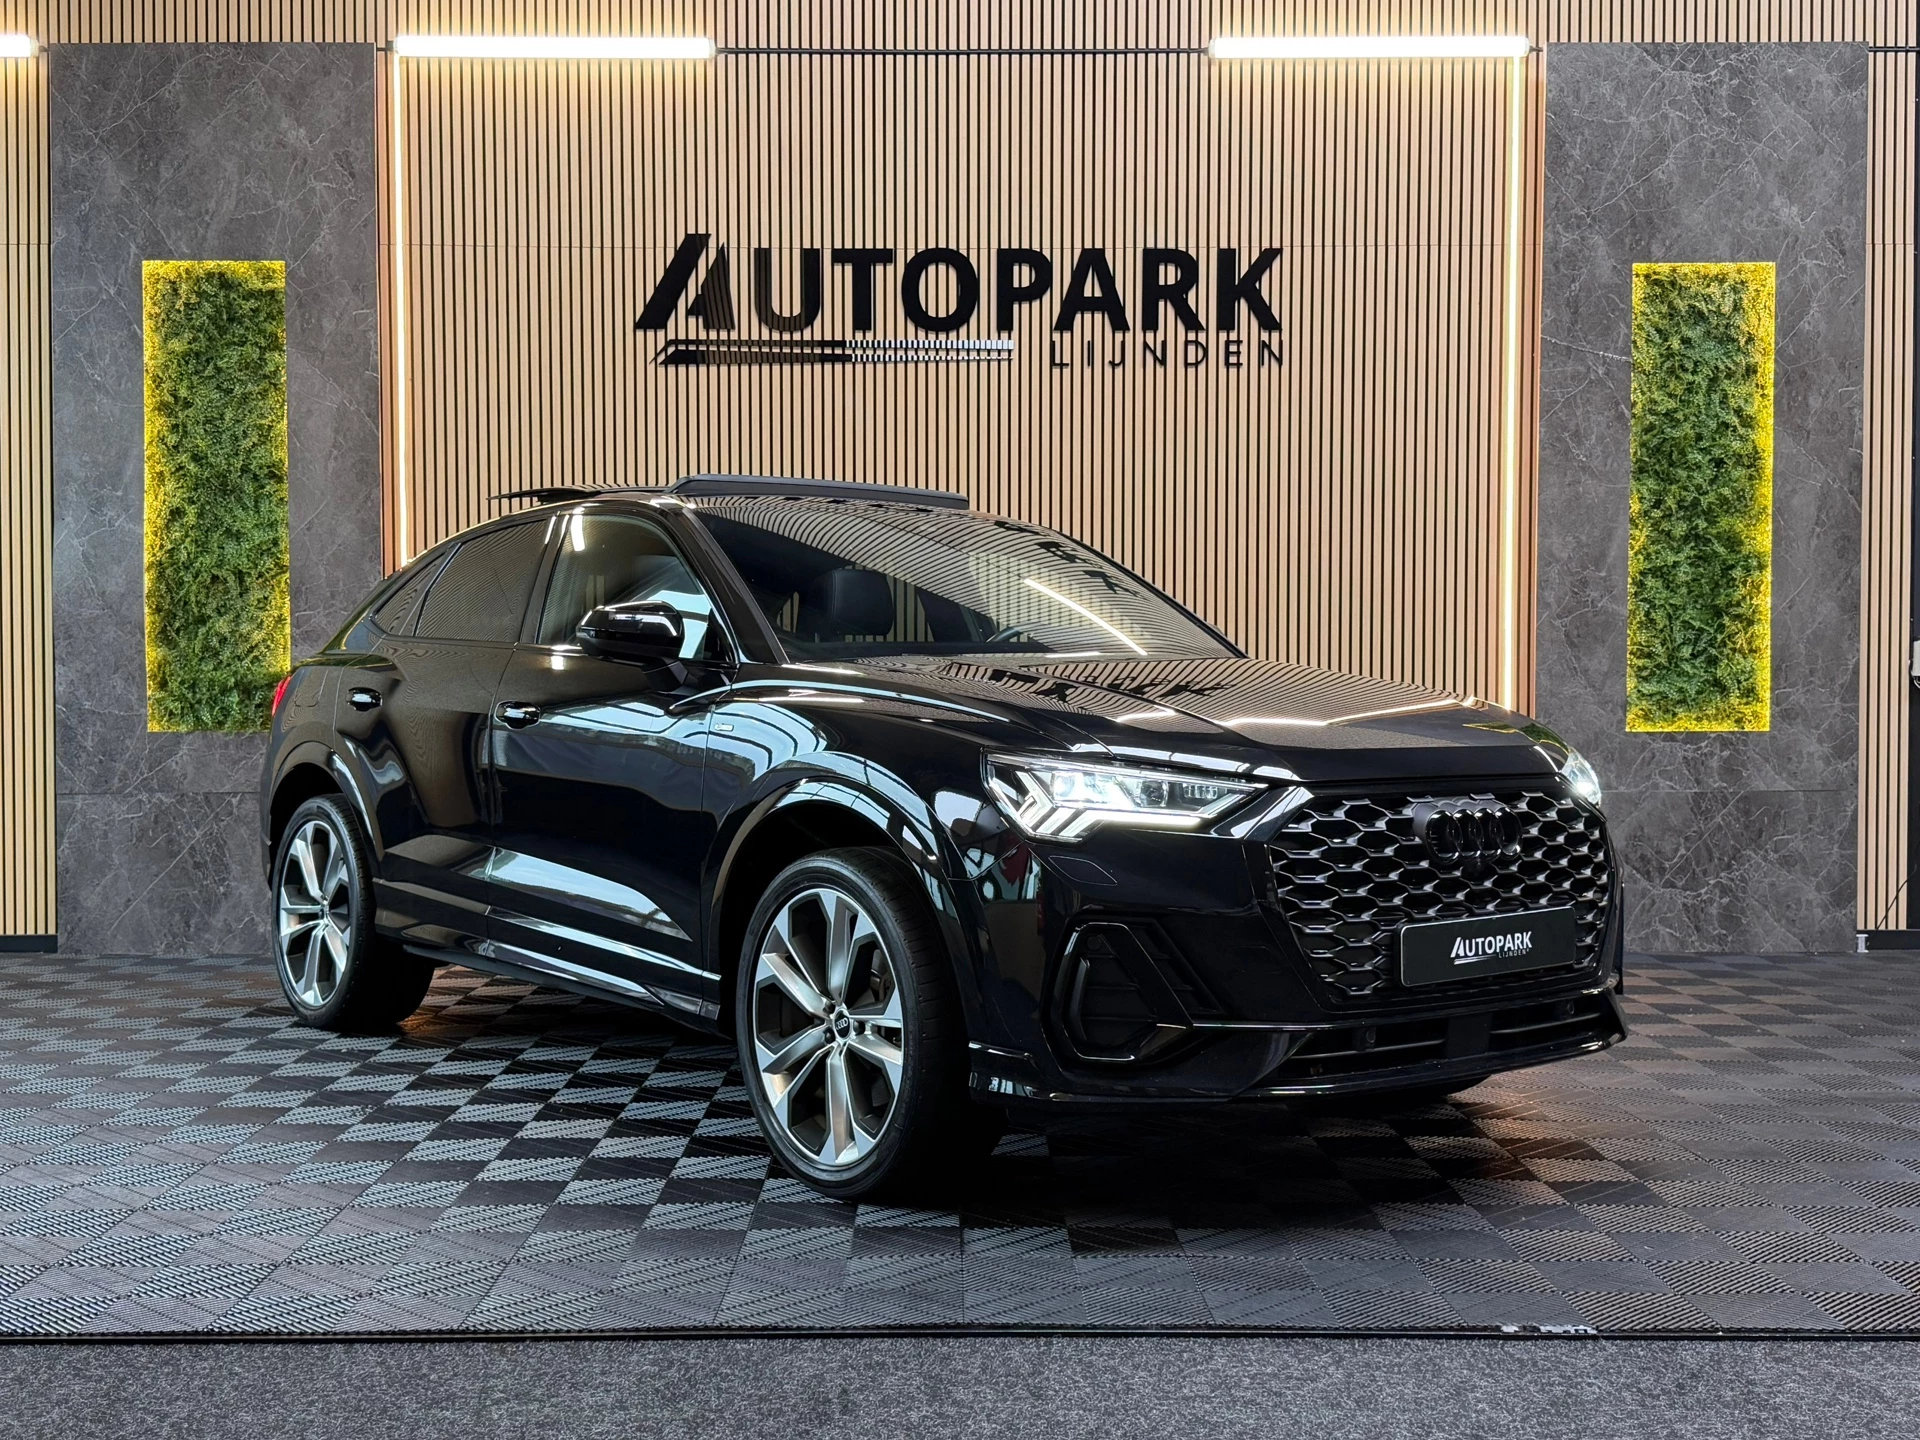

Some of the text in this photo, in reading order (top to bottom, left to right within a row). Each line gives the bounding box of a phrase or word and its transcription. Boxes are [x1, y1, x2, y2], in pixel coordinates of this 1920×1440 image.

[633, 233, 1283, 333] AUTOPARK
[1052, 339, 1283, 369] LIJNDEN
[1450, 931, 1532, 958] AUTOPARK
